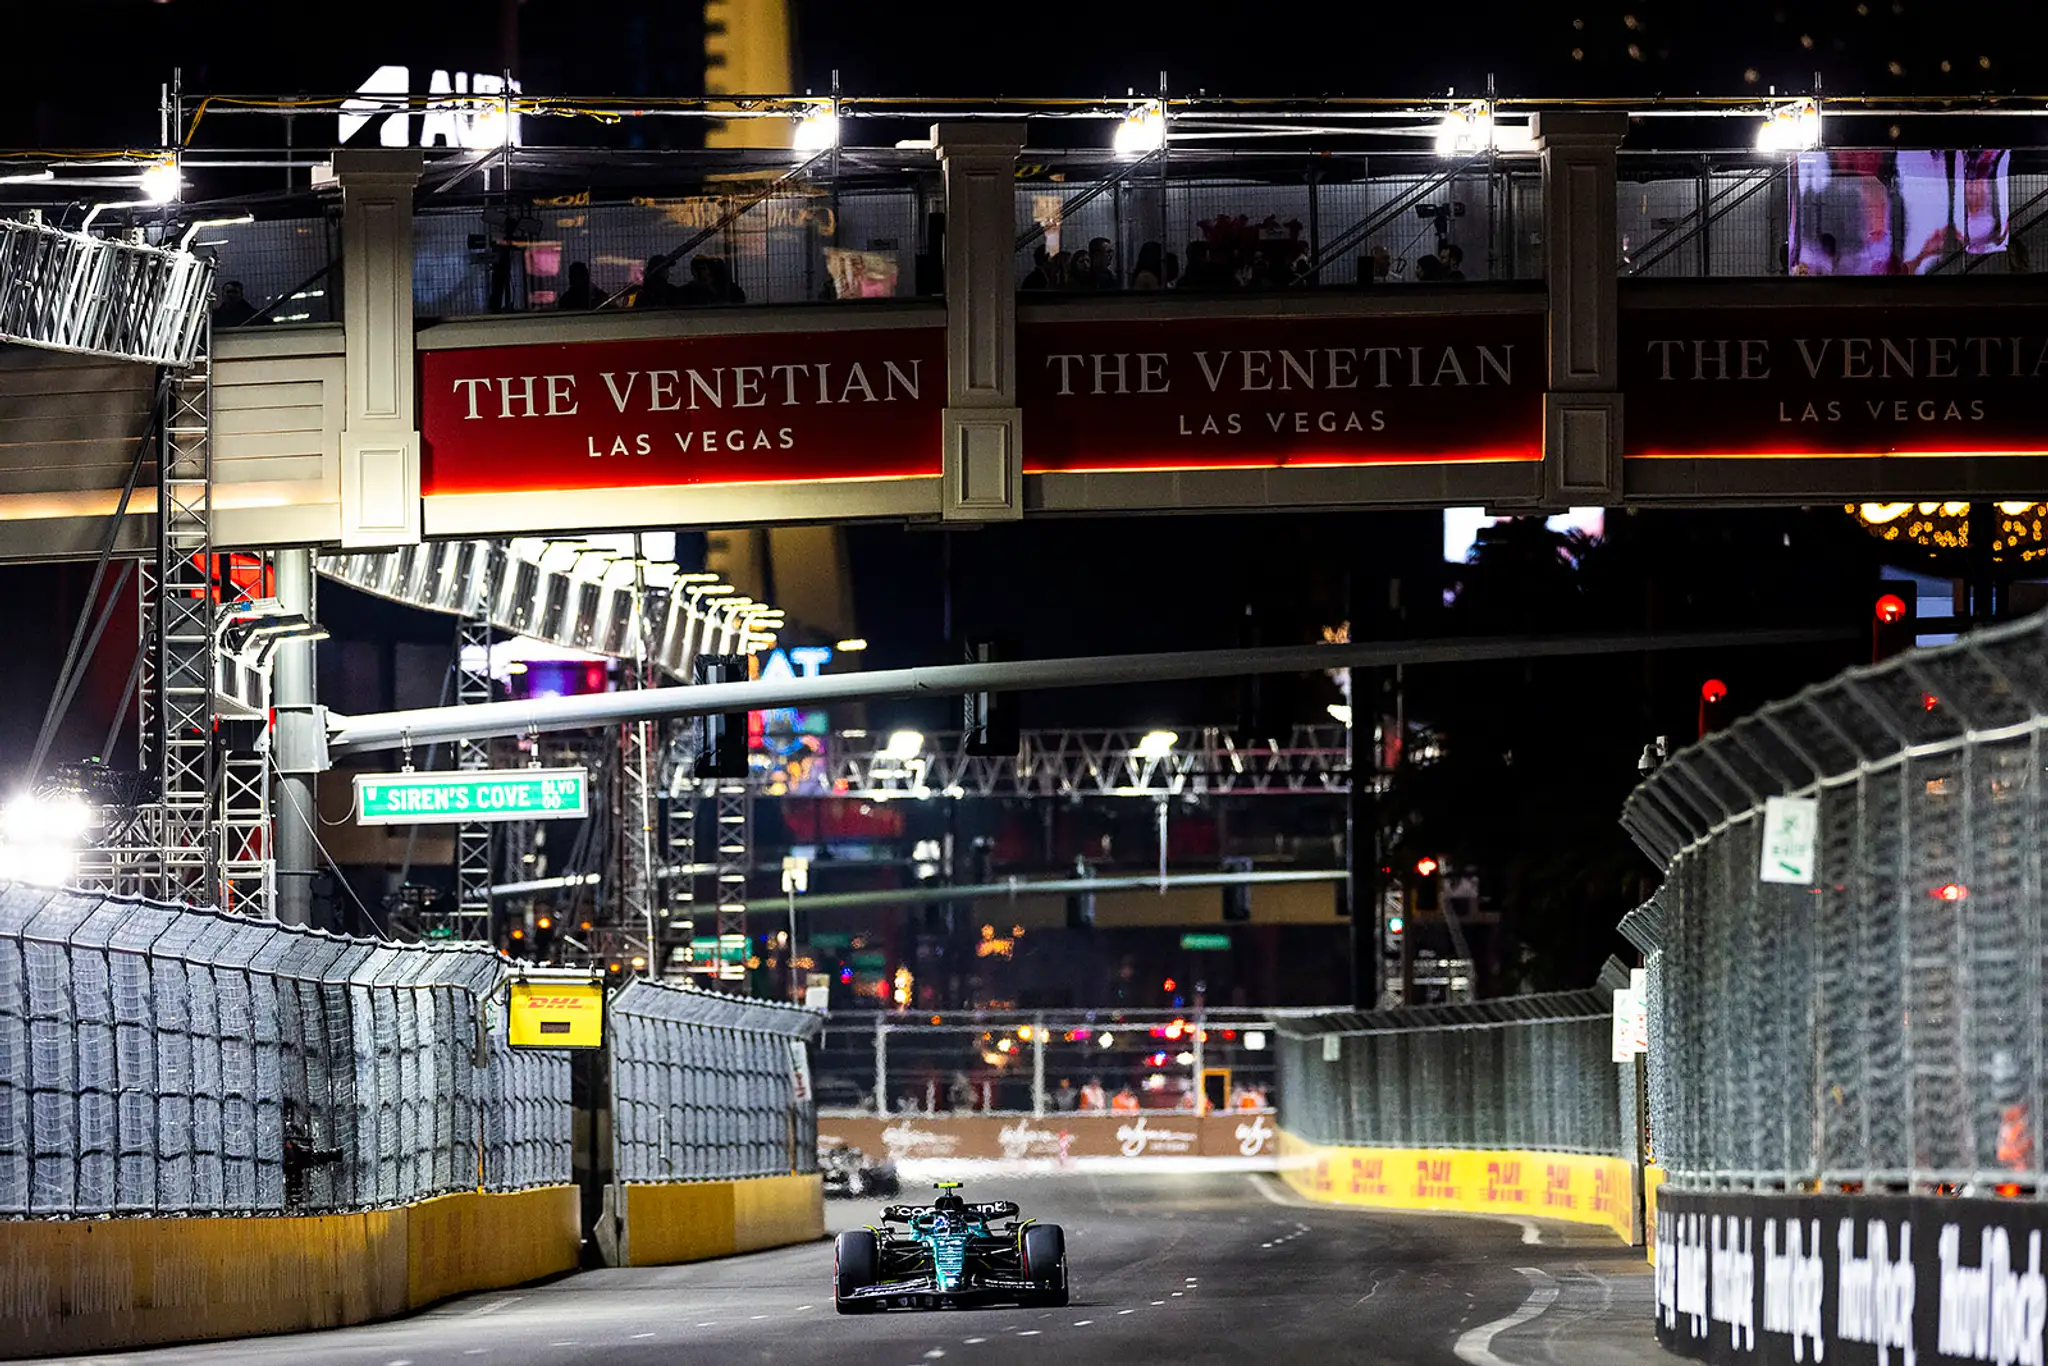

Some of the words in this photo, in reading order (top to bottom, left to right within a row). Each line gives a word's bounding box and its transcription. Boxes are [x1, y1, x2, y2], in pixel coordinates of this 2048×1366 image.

[1046, 353, 1171, 396] THE
[1193, 345, 1515, 392] VENETIAN
[1647, 340, 1771, 380] THE
[453, 374, 579, 419] THE
[600, 359, 923, 413] VENETIAN
[1179, 414, 1242, 435] LAS
[1266, 410, 1385, 432] VEGAS
[1779, 401, 1842, 422] LAS
[1866, 400, 1985, 421] VEGAS
[588, 434, 651, 457] LAS
[675, 428, 795, 452] VEGAS
[366, 787, 377, 800] W
[387, 786, 469, 811] SIREN'S
[476, 785, 531, 808] COVE
[541, 779, 575, 796] BLVD
[528, 997, 583, 1009] DHL
